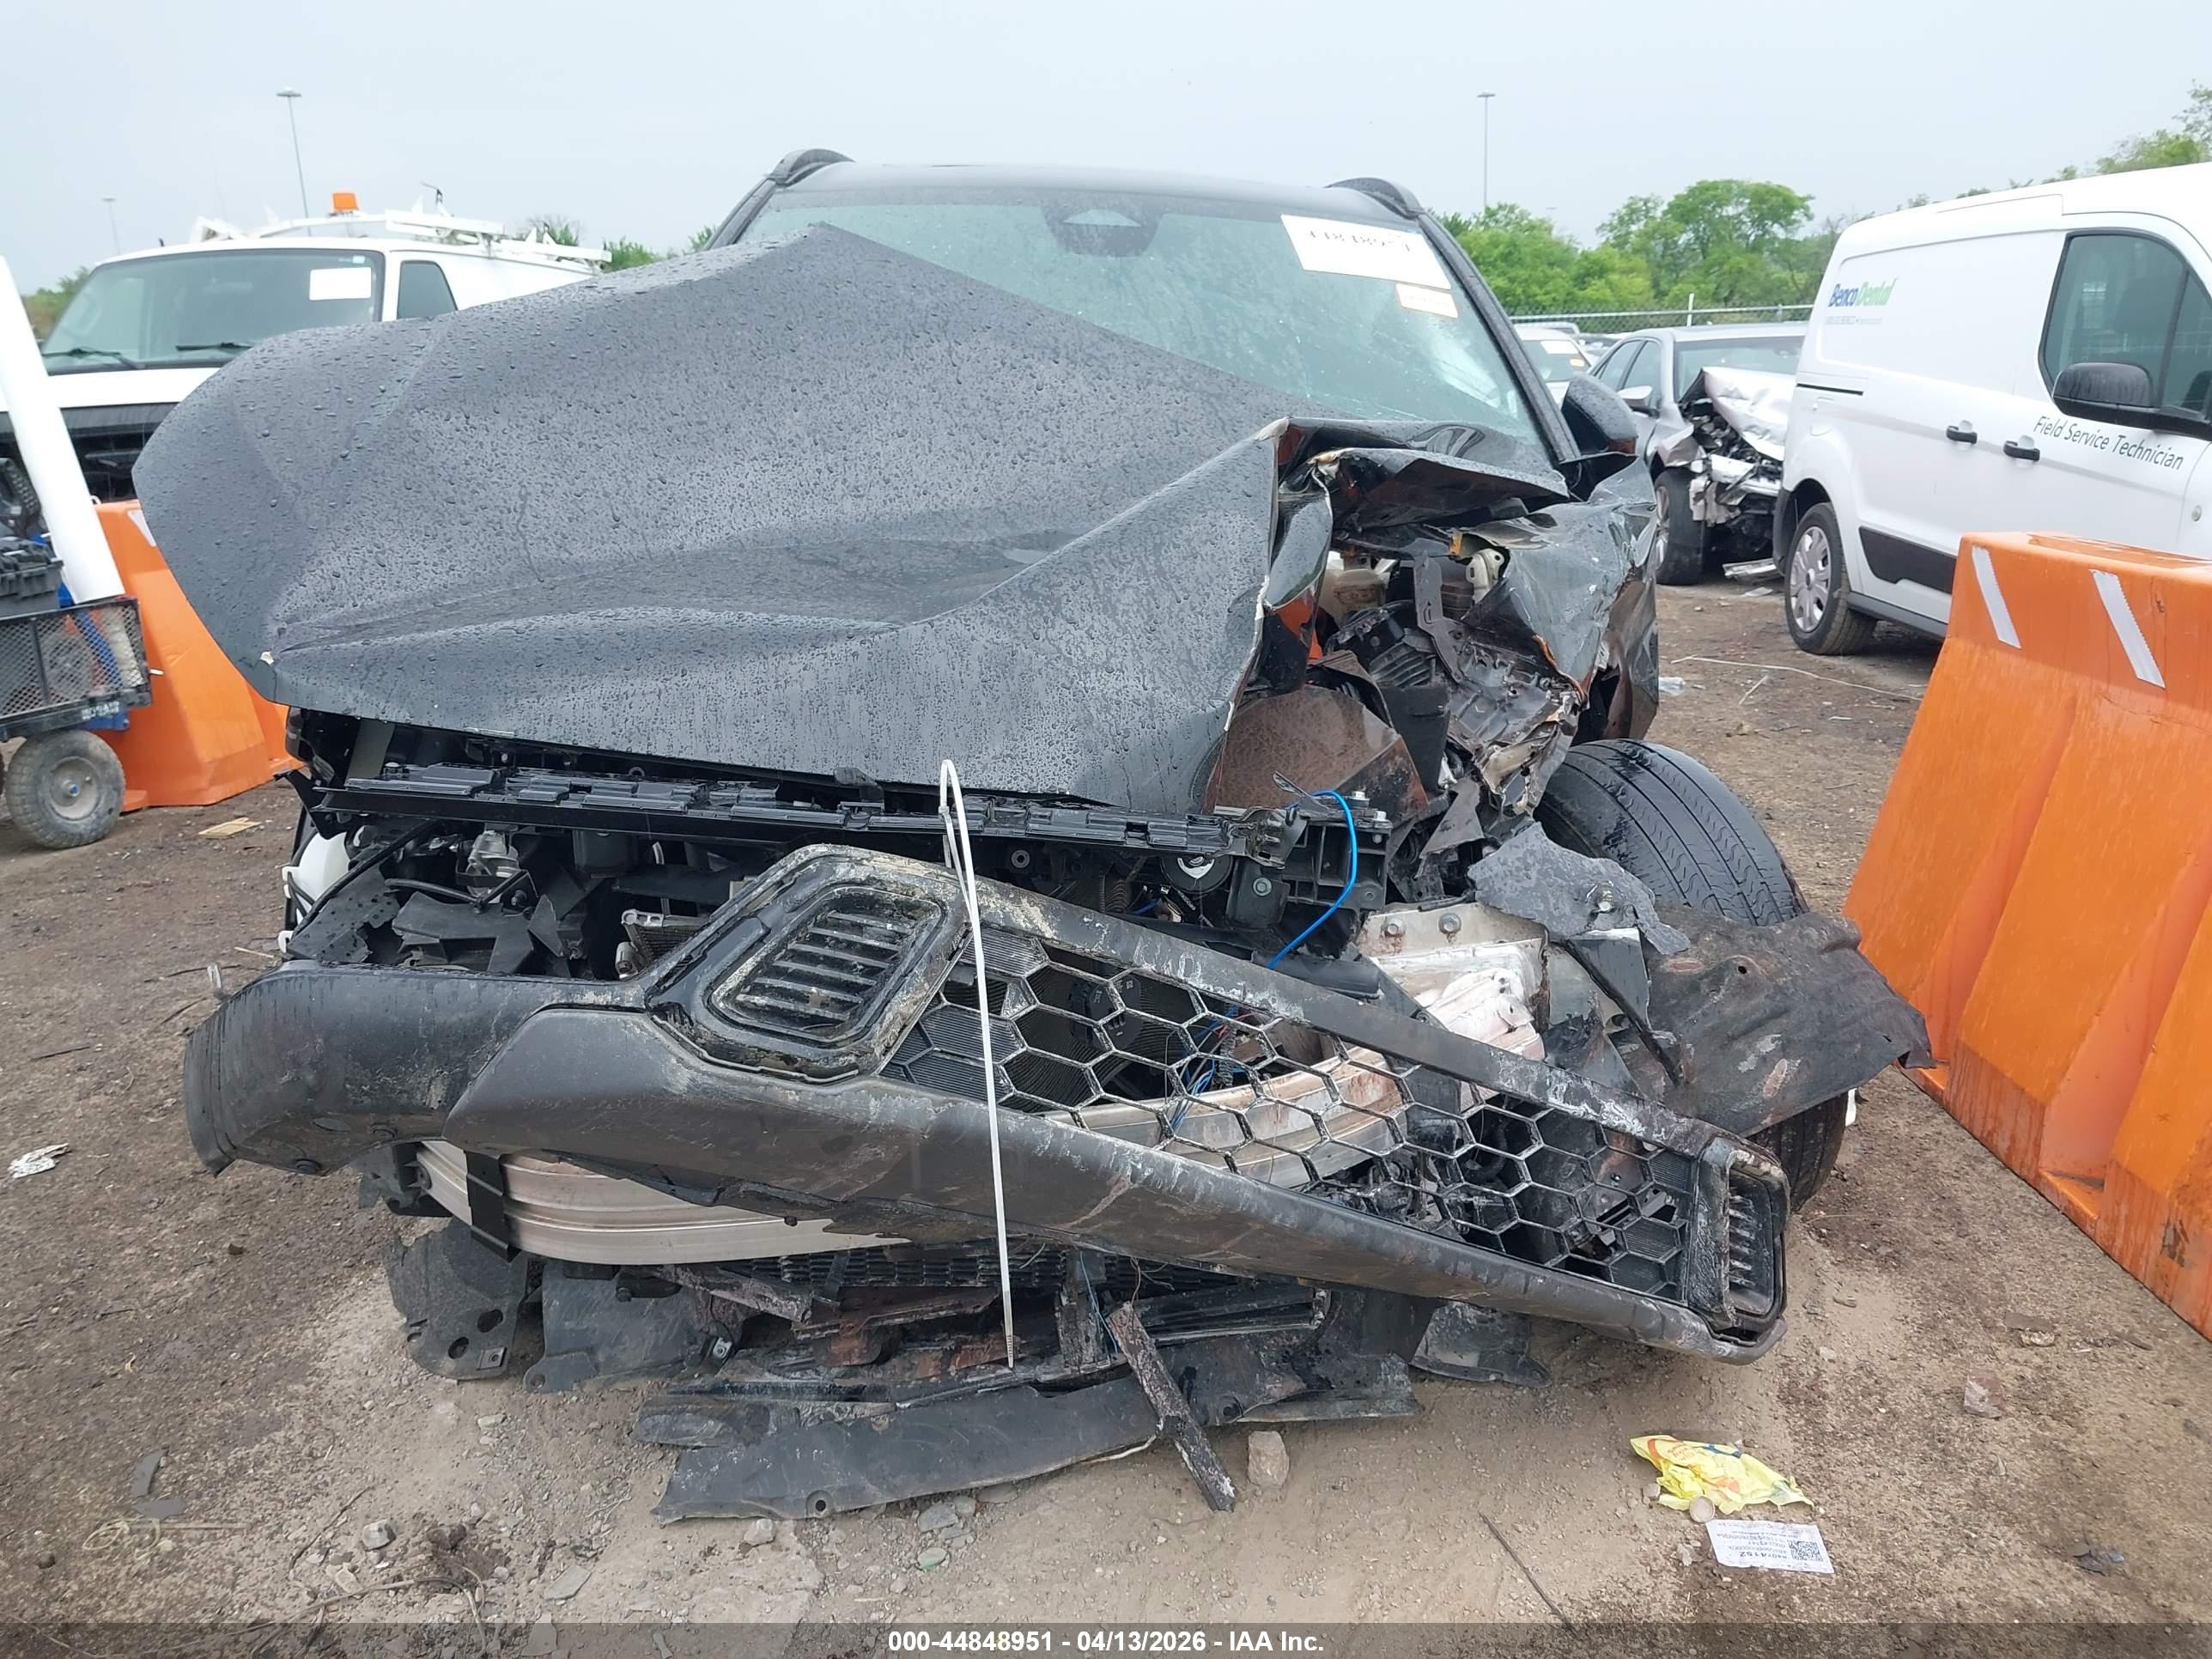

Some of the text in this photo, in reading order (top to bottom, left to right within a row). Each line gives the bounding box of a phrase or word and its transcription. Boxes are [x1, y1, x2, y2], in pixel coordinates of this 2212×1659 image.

[2034, 416, 2185, 470] Field Service Technician
